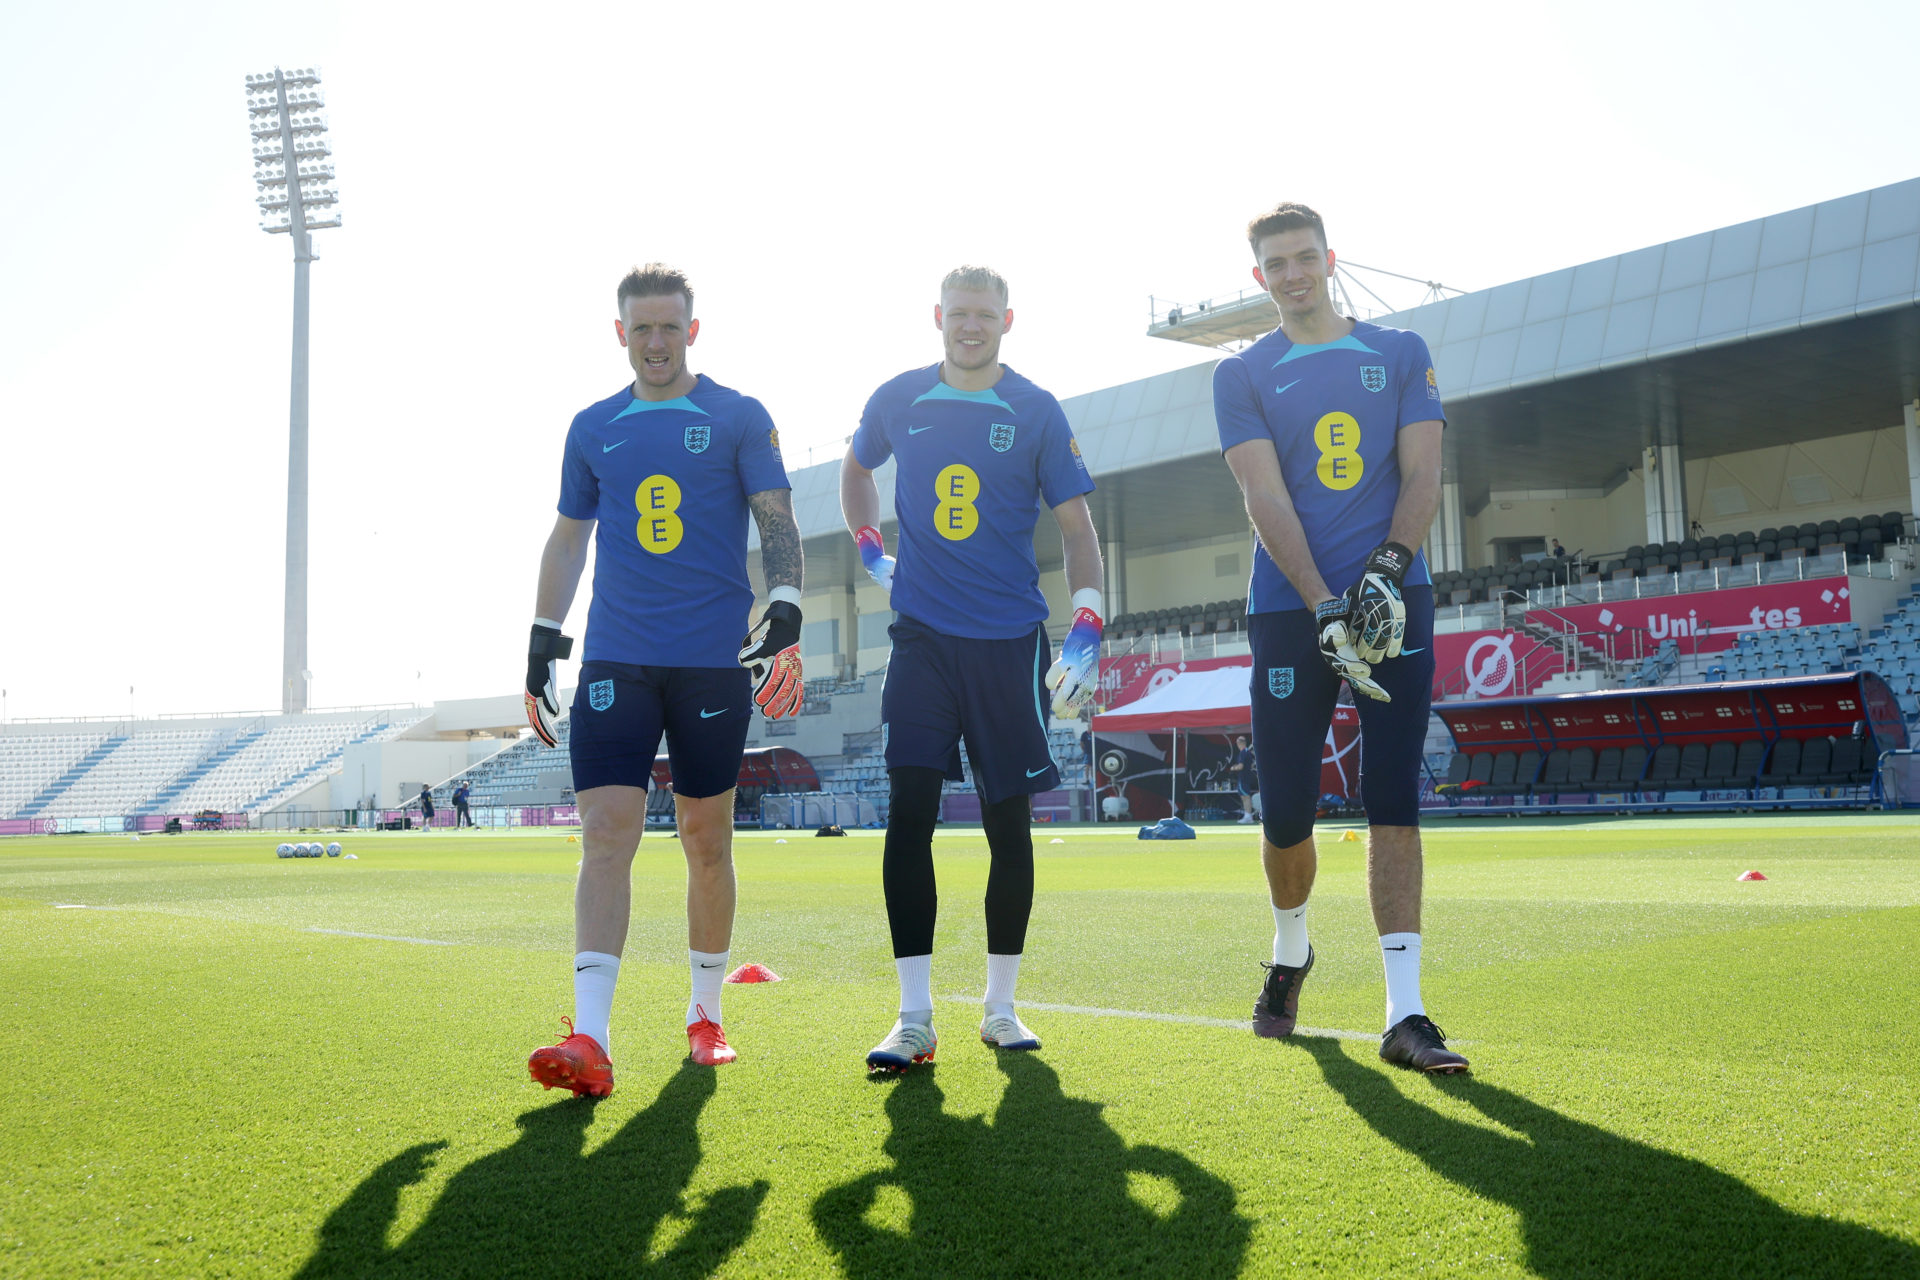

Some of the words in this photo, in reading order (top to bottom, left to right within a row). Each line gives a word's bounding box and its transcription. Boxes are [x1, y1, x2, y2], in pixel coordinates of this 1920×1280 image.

[1375, 555, 1402, 569] POPE
[1376, 559, 1398, 571] NICK
[1083, 612, 1095, 622] 32
